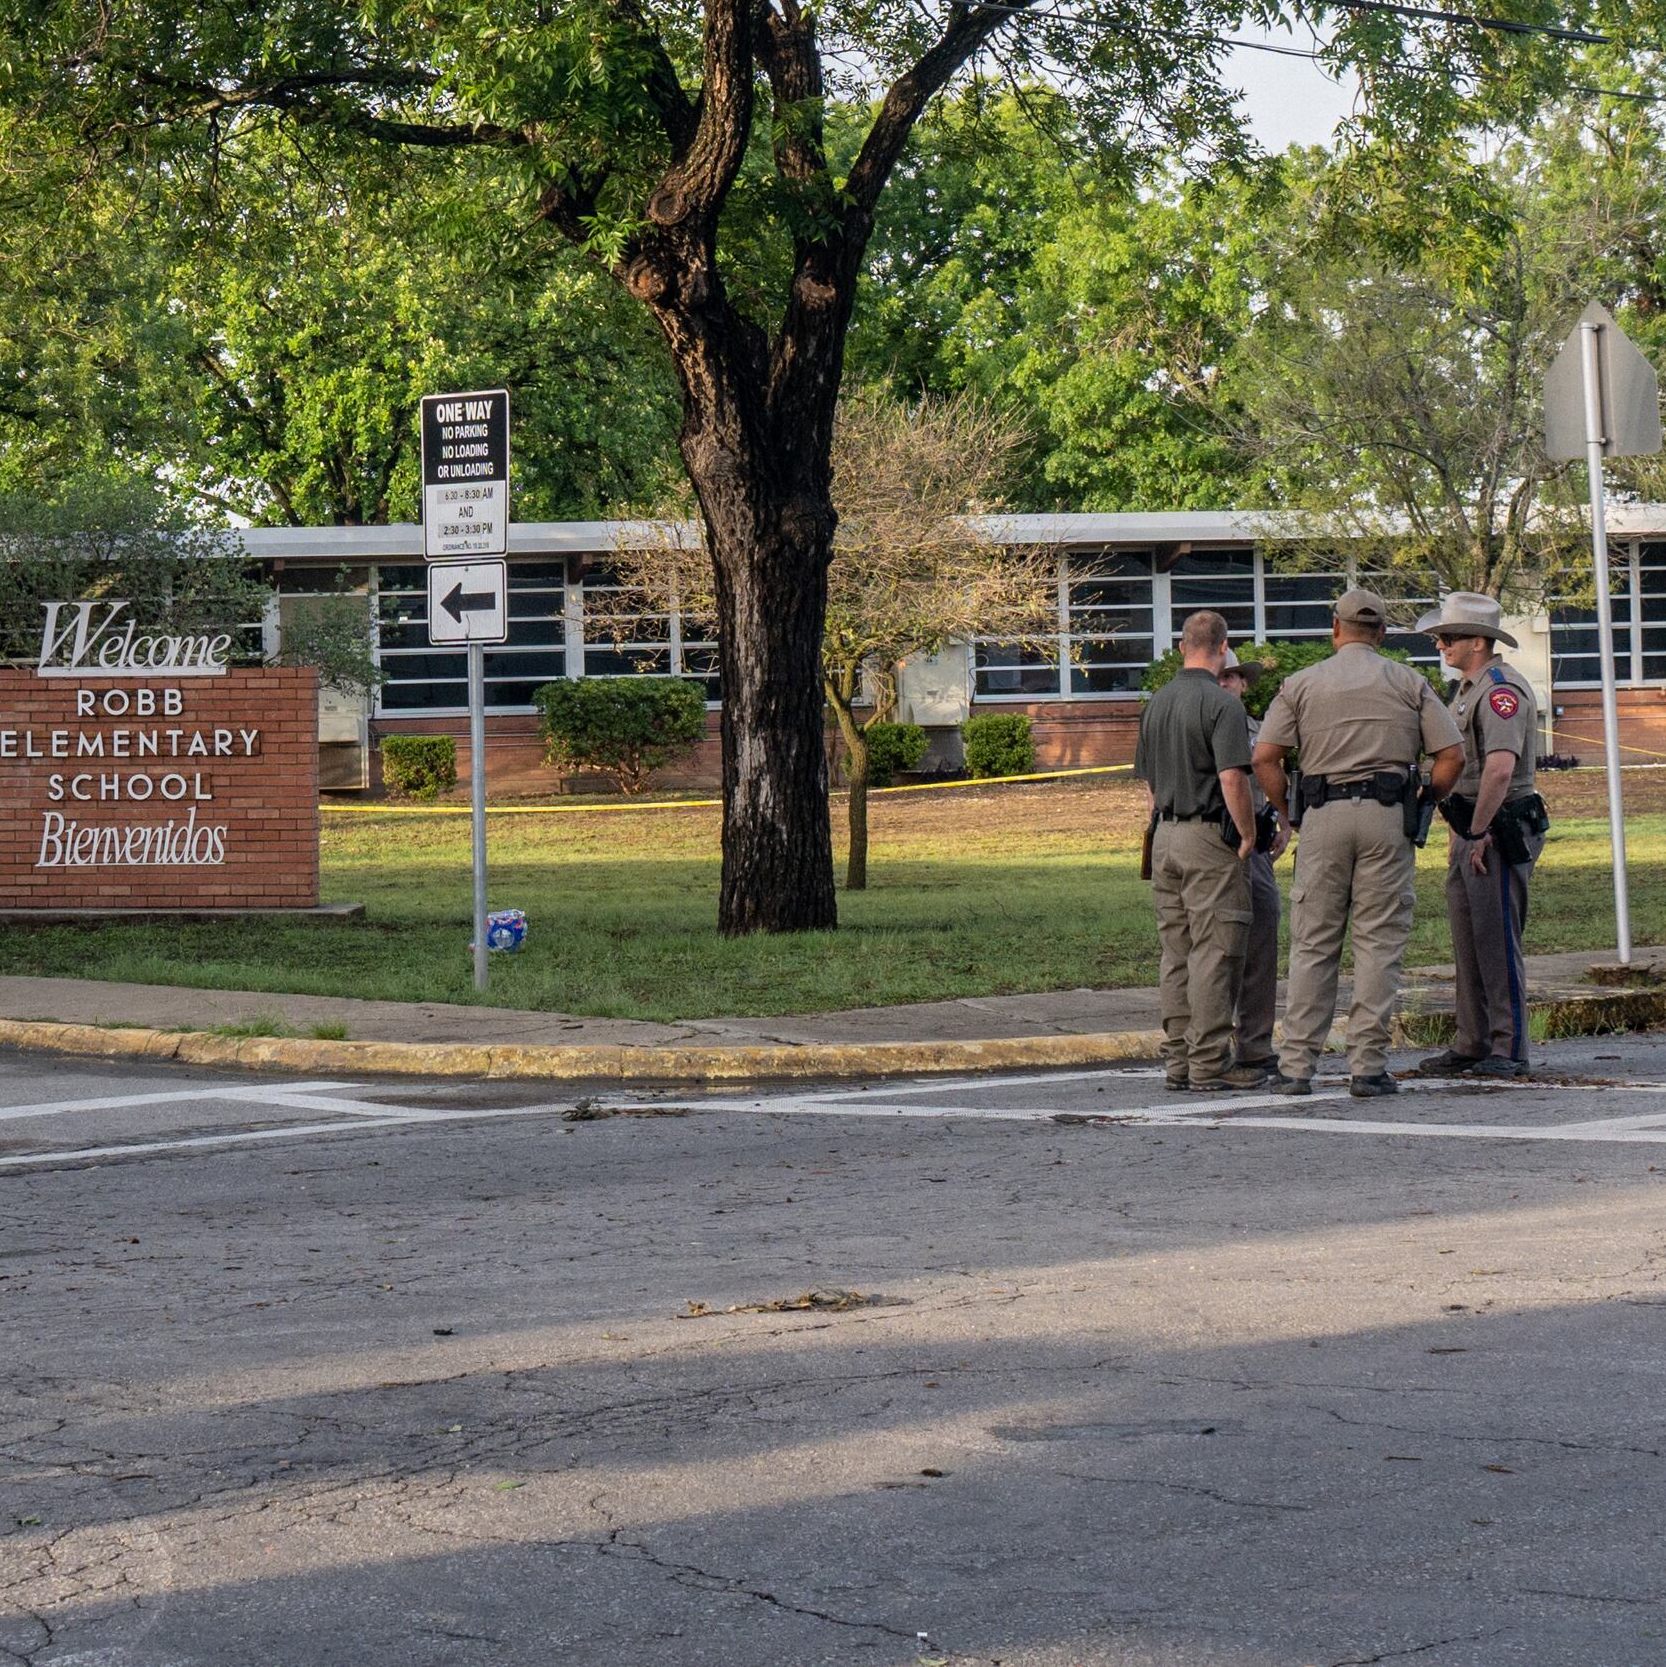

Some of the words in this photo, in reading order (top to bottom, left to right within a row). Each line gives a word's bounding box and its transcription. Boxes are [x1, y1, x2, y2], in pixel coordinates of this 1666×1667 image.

[436, 402, 463, 423] ONE
[465, 399, 493, 421] WAY
[442, 426, 454, 440] NO
[455, 423, 488, 439] PARKING
[442, 445, 454, 459] NO
[455, 443, 489, 458] LOADING
[437, 464, 450, 479] OR
[450, 461, 494, 478] UNLOADING
[444, 490, 458, 501] 6:30
[464, 489, 481, 500] 8:30
[482, 487, 493, 499] AM
[458, 505, 474, 518] AND
[443, 525, 459, 535] 2:30
[465, 524, 481, 534] 3:30
[482, 522, 493, 535] PM
[38, 601, 232, 670] Welcome
[77, 688, 184, 717] ROBB
[0, 729, 258, 757] ELEMENTARY
[48, 772, 213, 801] SCHOOL
[36, 806, 228, 866] Bienvenidos
